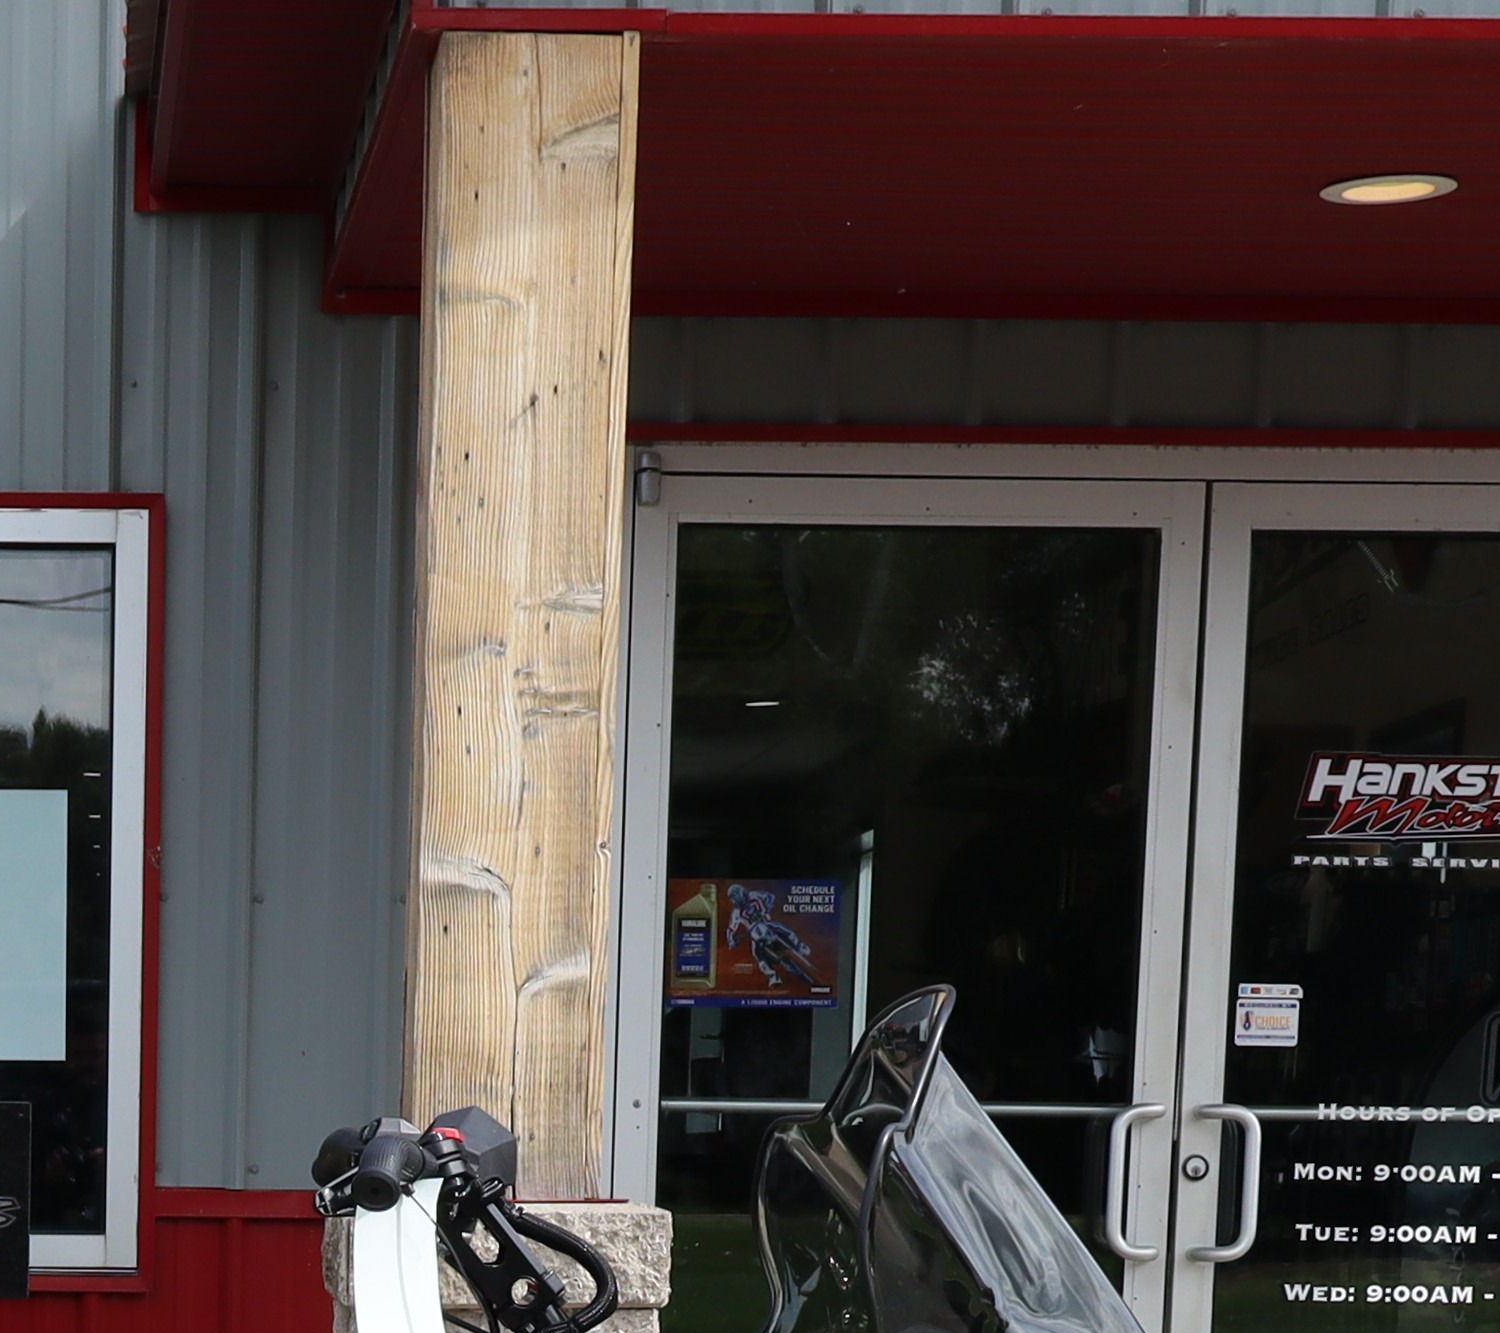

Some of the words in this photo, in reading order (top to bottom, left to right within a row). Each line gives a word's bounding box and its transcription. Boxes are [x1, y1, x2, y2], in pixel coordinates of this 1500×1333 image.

[1293, 855, 1390, 867] PARTS
[791, 886, 835, 895] SCHEDULE
[787, 895, 811, 904] YOUR
[813, 895, 835, 904] NEXT
[783, 904, 797, 913] OIL
[799, 904, 835, 913] CHANGE
[1374, 1164, 1482, 1184] 9:00AM
[1370, 1225, 1477, 1244] 9:00AM
[1366, 1284, 1473, 1304] 9:00AM
